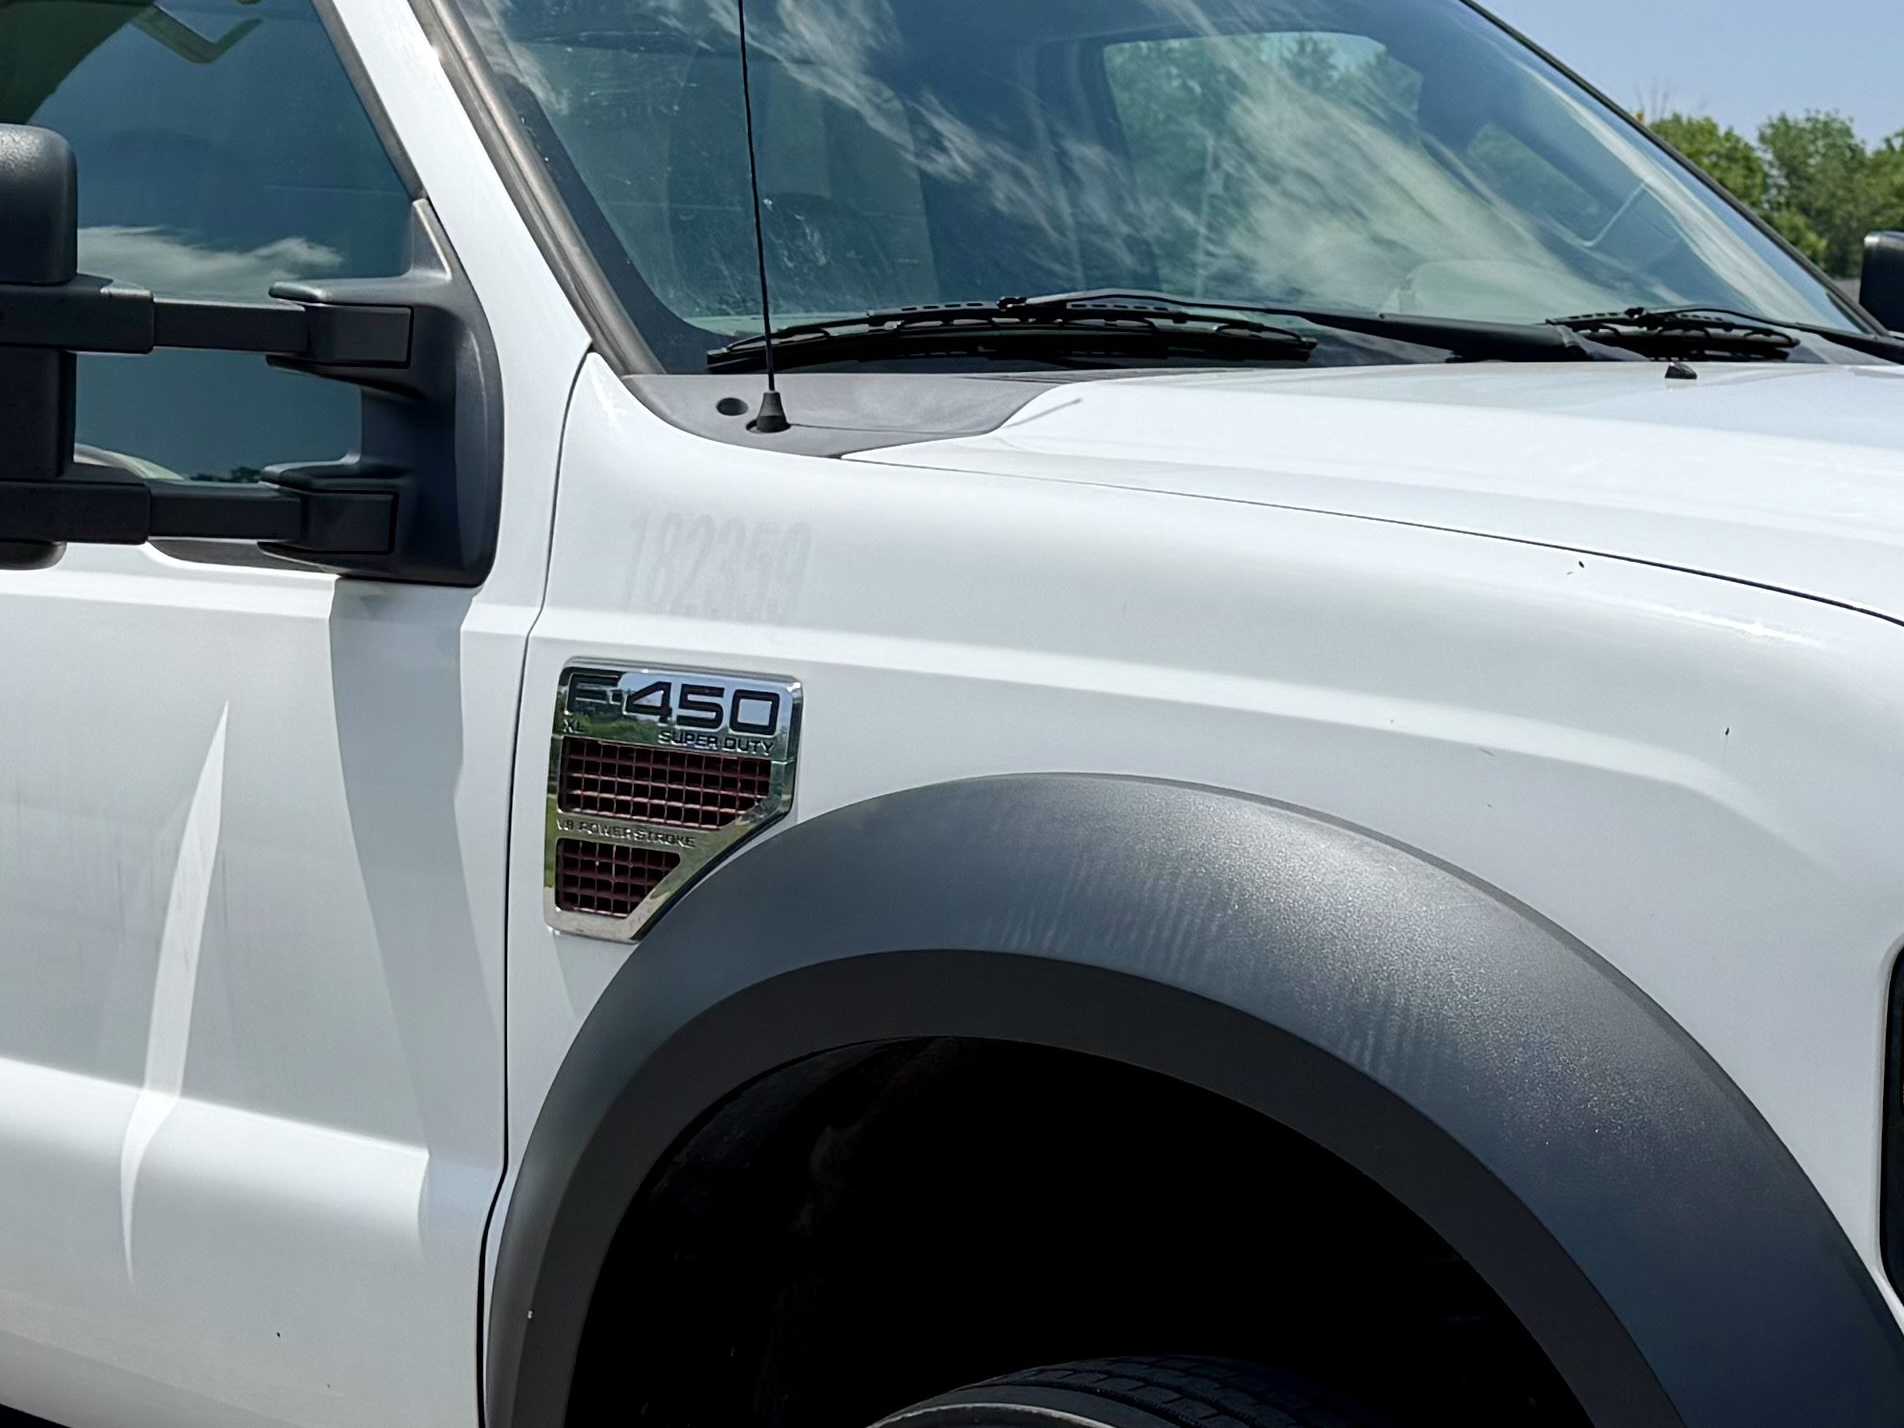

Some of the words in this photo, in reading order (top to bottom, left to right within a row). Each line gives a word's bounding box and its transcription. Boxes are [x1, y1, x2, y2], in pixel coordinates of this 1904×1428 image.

[564, 673, 781, 736] F-450
[657, 729, 719, 751] SUPER
[721, 737, 774, 757] DUTY
